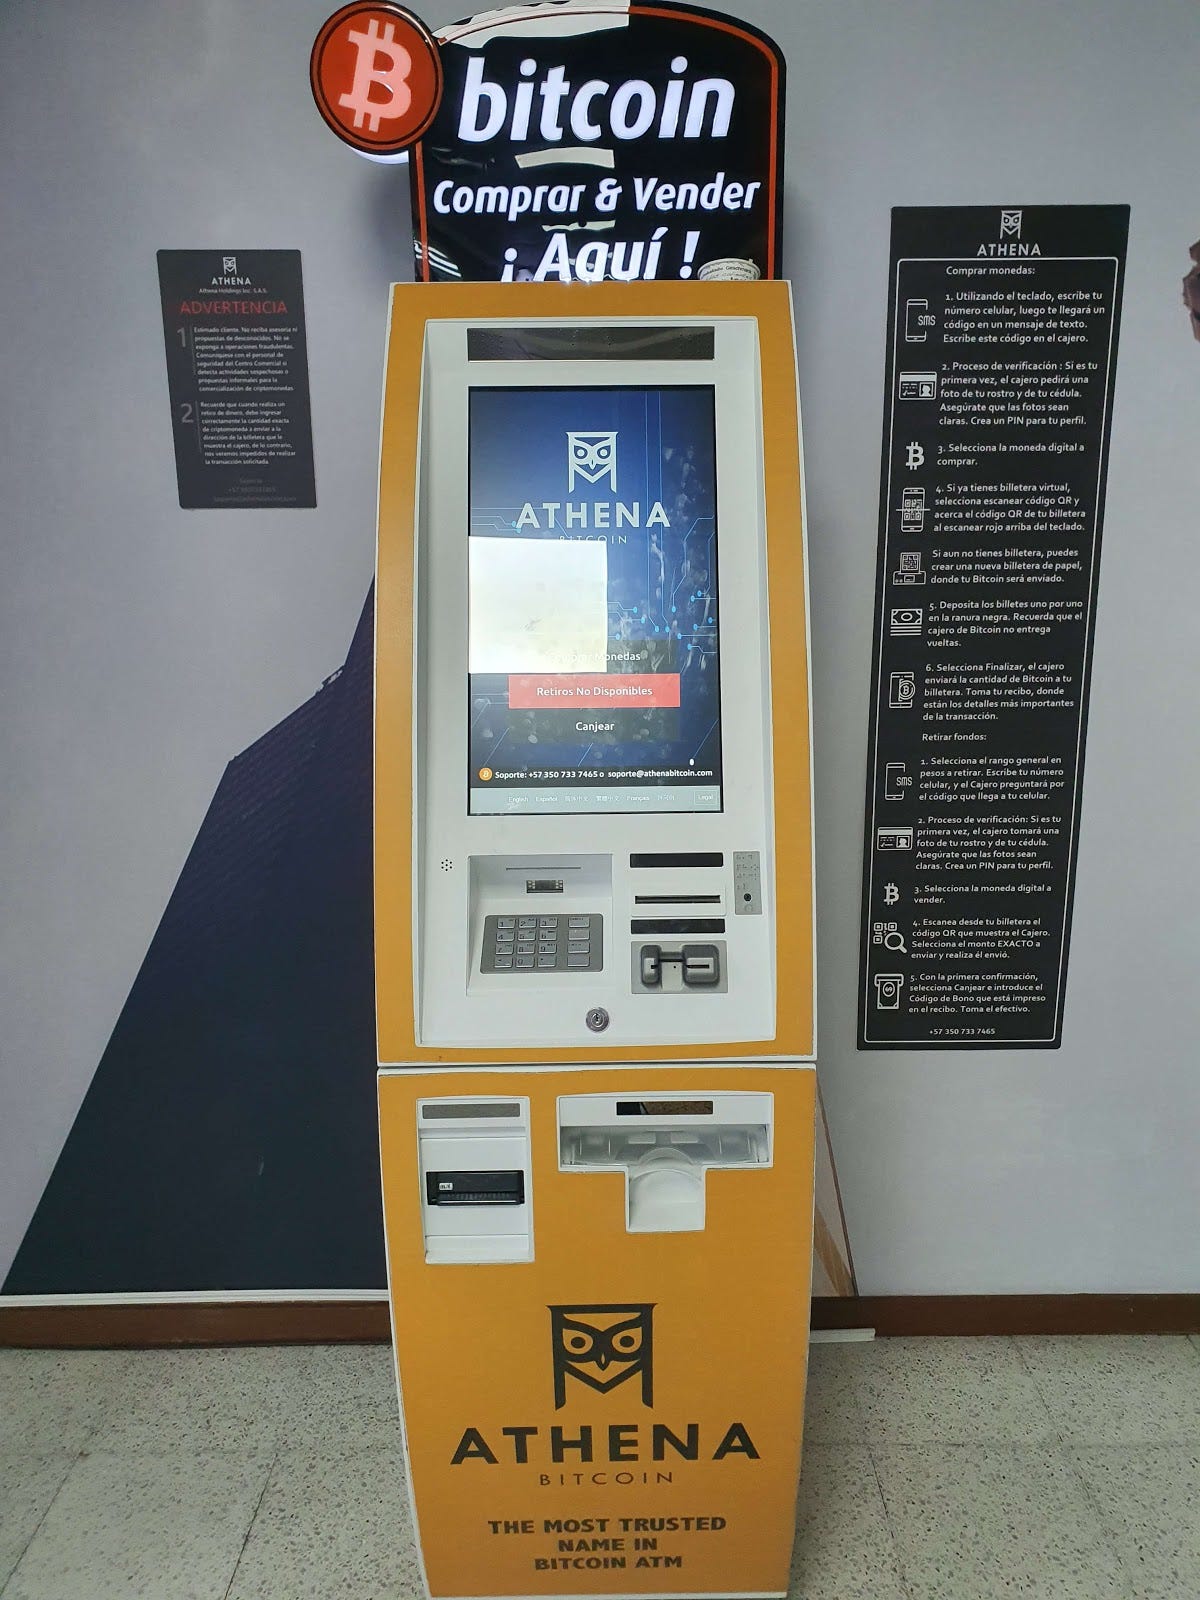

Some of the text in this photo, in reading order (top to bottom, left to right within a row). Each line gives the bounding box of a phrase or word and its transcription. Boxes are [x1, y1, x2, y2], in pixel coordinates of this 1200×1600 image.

[458, 56, 735, 142] bitcoin
[433, 172, 761, 222] Comprar & Vender
[533, 226, 669, 282] Aquí
[976, 244, 1041, 257] ATHENA
[946, 266, 1035, 276] Comprar monedas:
[956, 292, 1004, 300] Utilizando
[1006, 291, 1014, 300] el
[1017, 291, 1054, 302] teclado,
[1057, 291, 1090, 299] escribe
[1092, 291, 1102, 299] tu
[180, 301, 288, 314] ADVERTENCIA
[944, 305, 981, 314] número
[982, 305, 1016, 316] celular,
[1019, 305, 1045, 316] luego
[1047, 305, 1057, 314] te
[1059, 305, 1091, 316] llegará
[917, 315, 936, 326] SMS
[943, 320, 975, 331] código
[1004, 320, 1044, 330] mensaje
[1045, 319, 1057, 328] de
[1059, 319, 1087, 328] texto.
[938, 416, 968, 424] claras.
[970, 416, 991, 424] Crea
[1007, 416, 1024, 424] PIN
[1025, 418, 1046, 427] para
[1048, 416, 1058, 424] tu
[1059, 416, 1086, 427] perfil.
[938, 446, 945, 454] 3.
[948, 443, 996, 452] Selecciona
[998, 443, 1007, 451] la
[1009, 443, 1046, 451] moneda
[1048, 443, 1077, 454] digital
[936, 459, 977, 467] comprar.
[935, 496, 981, 504] selecciona
[1025, 496, 1055, 506] código
[1057, 496, 1072, 504] QR
[516, 502, 670, 528] ATHENA
[930, 574, 1064, 582] donde tu Bitcoin será enviado.
[929, 603, 936, 611] 5.
[939, 600, 979, 611] Deposita
[981, 600, 994, 608] los
[996, 599, 1028, 608] billetes
[1048, 601, 1064, 610] por
[926, 638, 961, 646] vueltas.
[598, 652, 640, 660] onedas
[537, 686, 653, 697] Retiros No Disponibles
[923, 699, 1074, 710] están los detalles más importantes
[922, 711, 998, 720] de la transacción.
[576, 722, 615, 732] Canjear
[922, 732, 986, 741] Retirar fondos:
[930, 756, 977, 764] Selecciona
[978, 756, 986, 764] el
[988, 758, 1014, 767] rango
[1016, 756, 1048, 766] general
[495, 771, 527, 780] Soporte:
[608, 770, 712, 779] soporte@athenabitcoin.com
[896, 776, 912, 786] SMS
[913, 895, 945, 904] vender.
[912, 928, 1050, 939] código QR que muestra el Cajero.
[911, 939, 956, 948] Selecciona
[957, 939, 965, 948] el
[967, 939, 995, 948] monto
[997, 939, 1033, 947] EXACTO
[910, 972, 1038, 983] 5. Con la primera confirmación,
[450, 1422, 760, 1464] ATHENA
[540, 1472, 672, 1486] BITCOIN
[488, 1516, 726, 1534] THE MOST TRUSTED
[558, 1538, 658, 1552] NAME IN
[535, 1555, 682, 1570] BITCOIN ATM
